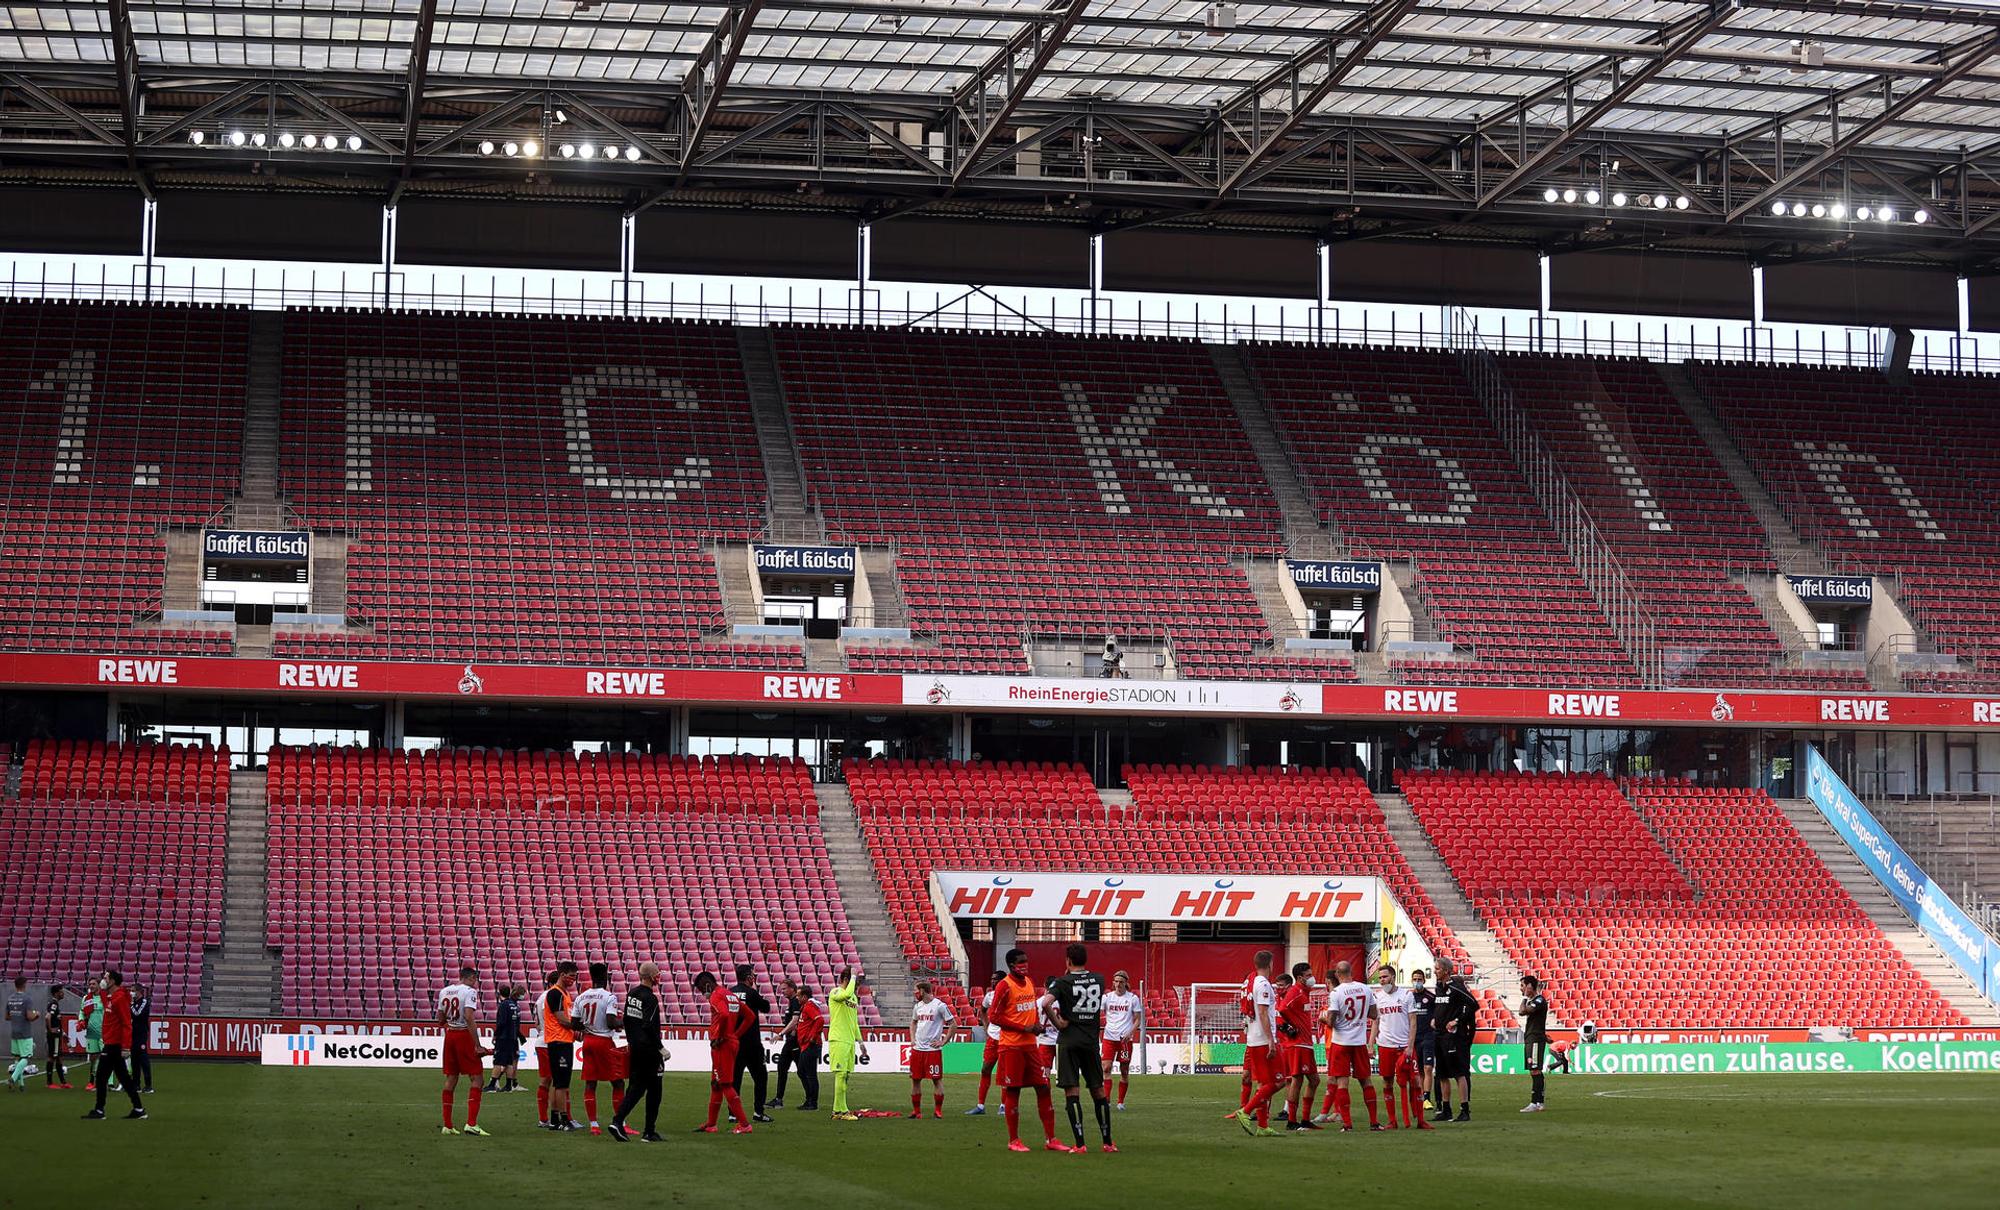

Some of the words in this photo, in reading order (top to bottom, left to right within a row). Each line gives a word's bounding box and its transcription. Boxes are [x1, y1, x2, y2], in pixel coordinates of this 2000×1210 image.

[206, 535, 252, 554] Gaffel
[256, 536, 307, 557] Kölsch
[755, 549, 800, 569] Gaffel
[802, 551, 854, 571] Kölsch
[1331, 565, 1380, 587] Kölsch
[1789, 579, 1824, 597] affel
[1826, 580, 1871, 600] Kölsch
[98, 659, 178, 684] REWE
[278, 664, 359, 688] REWE
[586, 671, 665, 696] REWE
[763, 676, 842, 700] REWE
[1384, 690, 1458, 713] REWE
[1548, 693, 1621, 717] REWE
[1820, 699, 1890, 722] REWE
[950, 886, 1034, 915] HIT
[1059, 888, 1145, 916] HIT
[1170, 890, 1254, 917] HIT
[1280, 891, 1363, 919] HIT
[442, 997, 460, 1021] 28
[1072, 984, 1101, 1013] 28
[1109, 1004, 1129, 1012] REWE
[1344, 995, 1367, 1021] 37
[1379, 1005, 1403, 1015] REWE
[583, 1002, 598, 1027] 11
[180, 1022, 219, 1051] DEIN
[323, 1042, 439, 1064] NetCologne
[1725, 1045, 1855, 1072] zuhause.
[929, 1064, 940, 1075] 30
